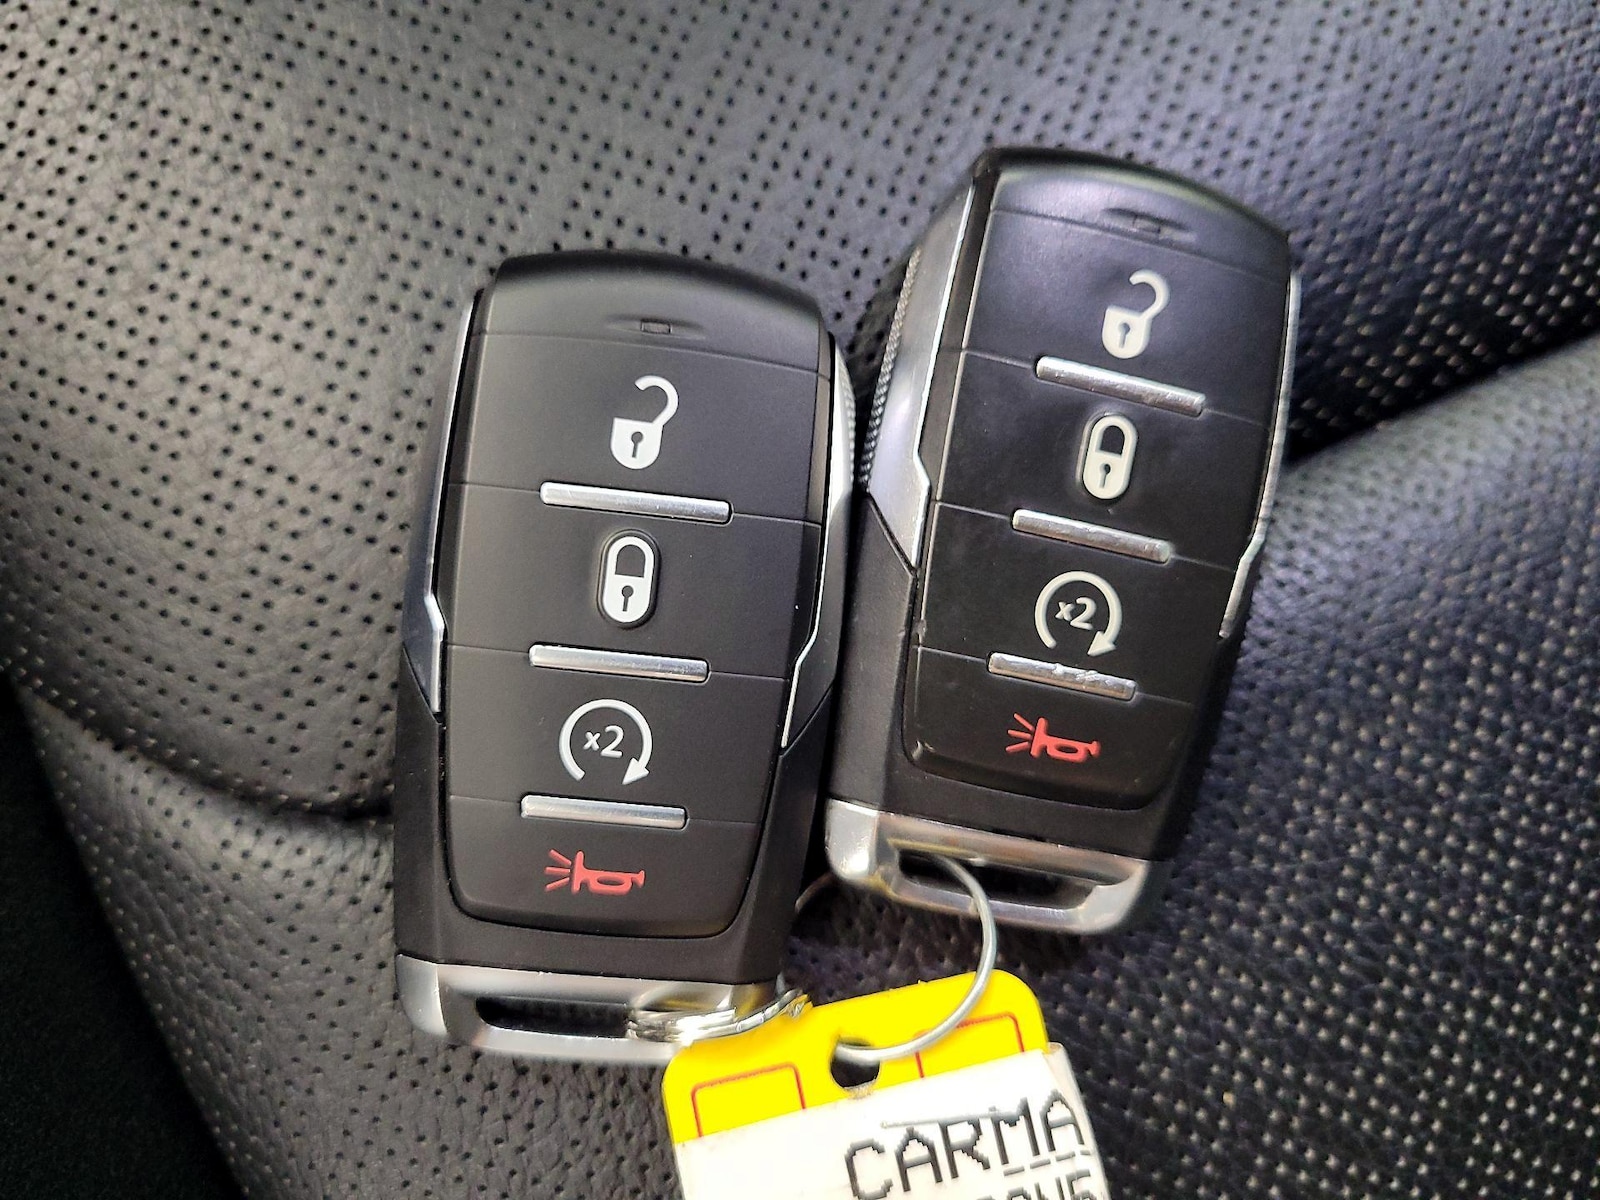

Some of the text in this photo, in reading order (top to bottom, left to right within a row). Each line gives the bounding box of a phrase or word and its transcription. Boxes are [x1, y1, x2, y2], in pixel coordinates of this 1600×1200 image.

[1055, 597, 1097, 630] x2
[583, 725, 624, 758] x2
[844, 1089, 1085, 1200] CARMA
